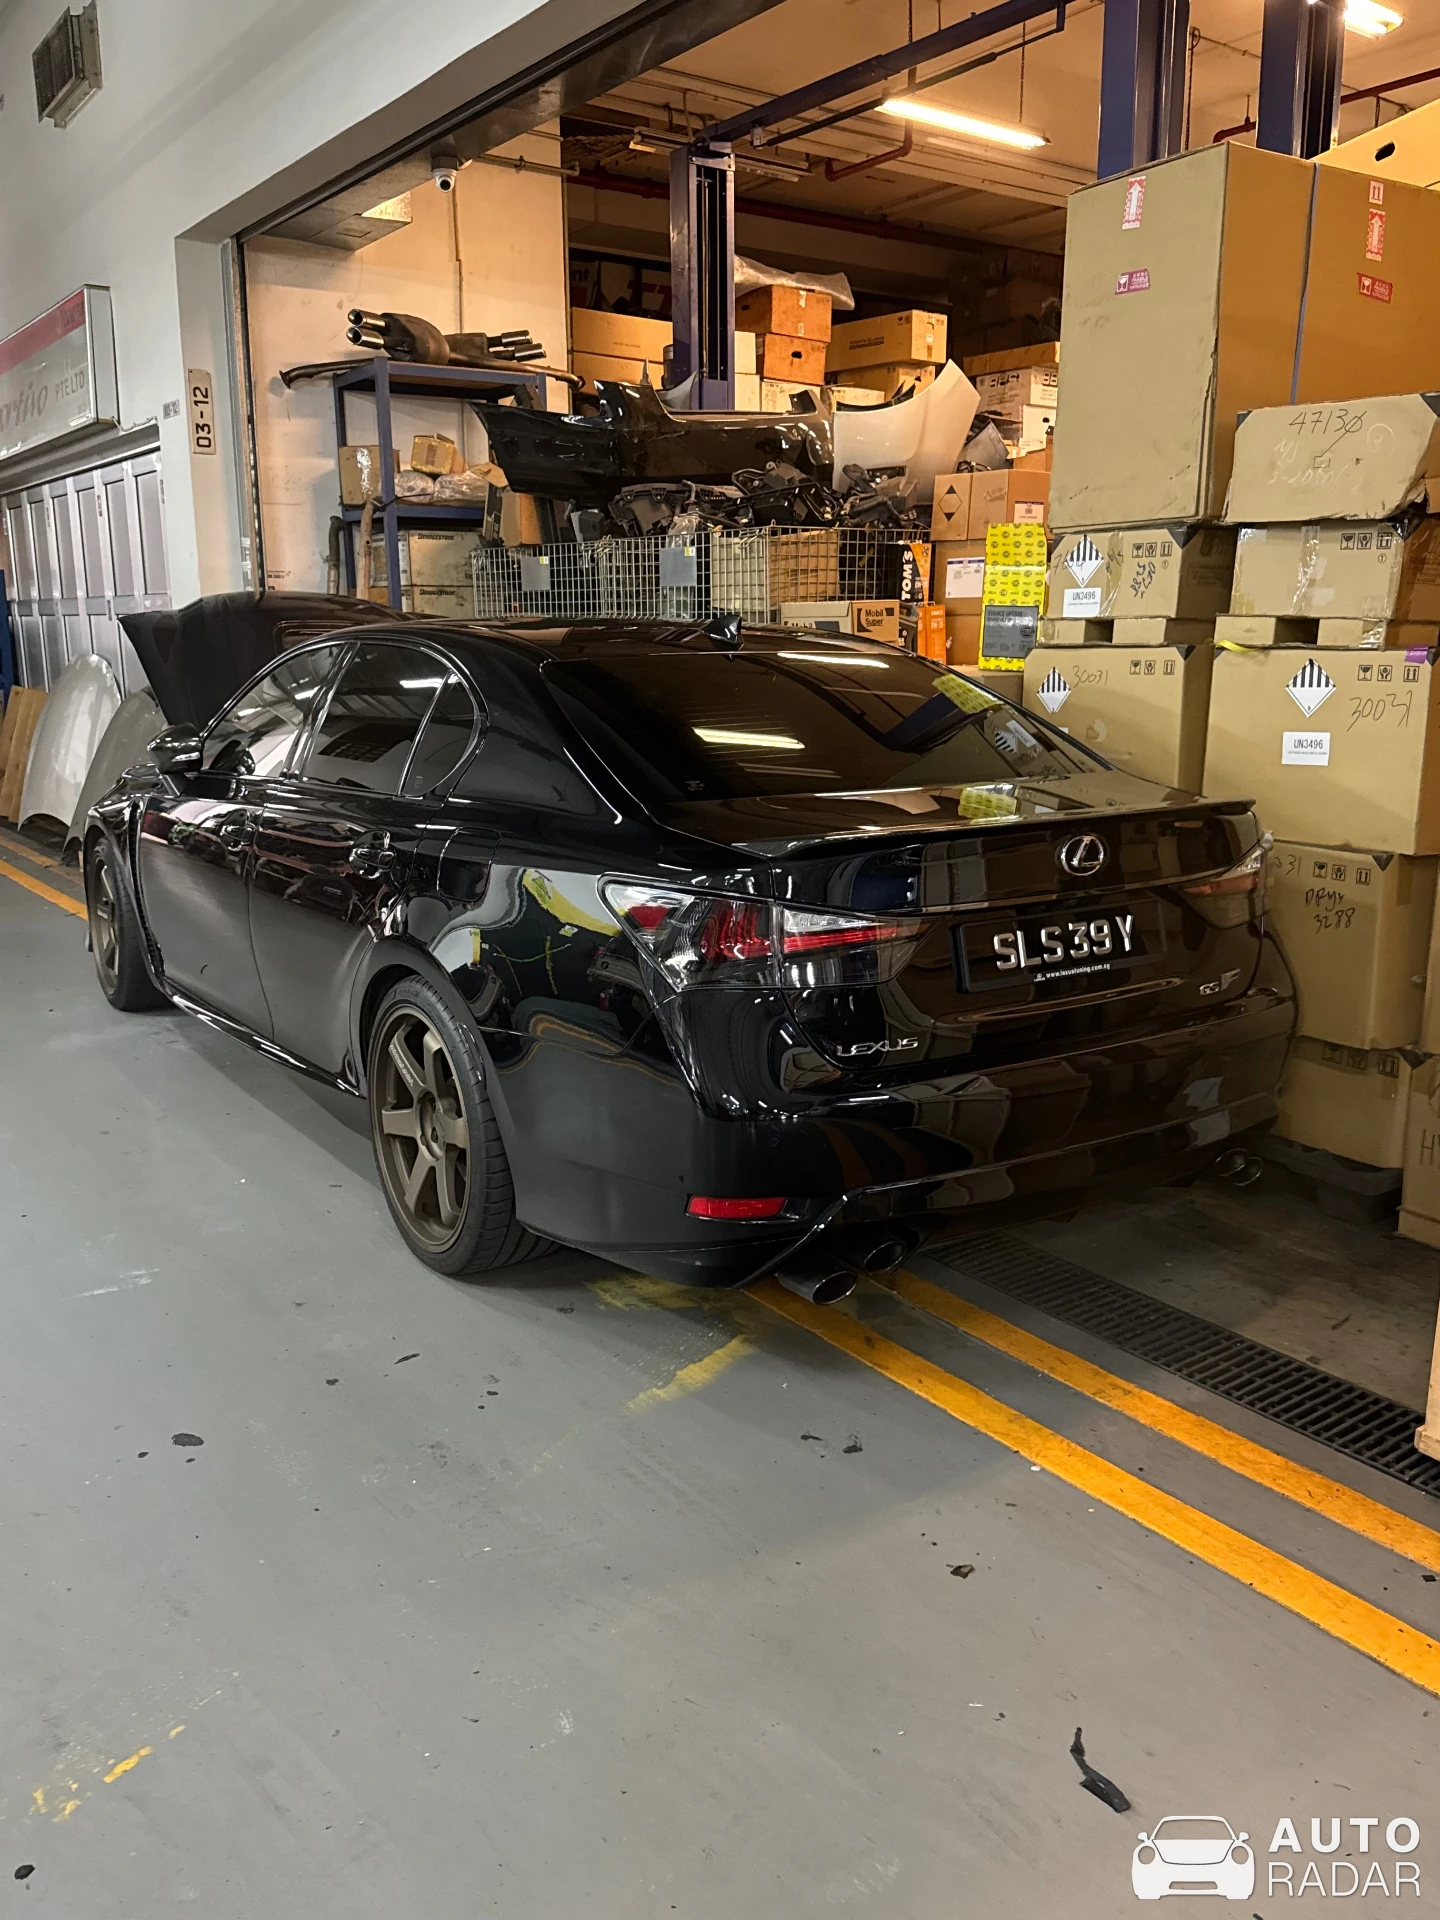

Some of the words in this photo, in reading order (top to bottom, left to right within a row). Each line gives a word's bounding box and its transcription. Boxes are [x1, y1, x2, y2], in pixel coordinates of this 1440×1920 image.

[193, 386, 212, 448] 03-12
[901, 550, 913, 601] TOM'S
[1072, 591, 1096, 601] UN3496
[865, 609, 884, 617] Mobil
[865, 618, 884, 627] Super
[1293, 739, 1324, 750] UN3496
[836, 1036, 919, 1057] LEXUS
